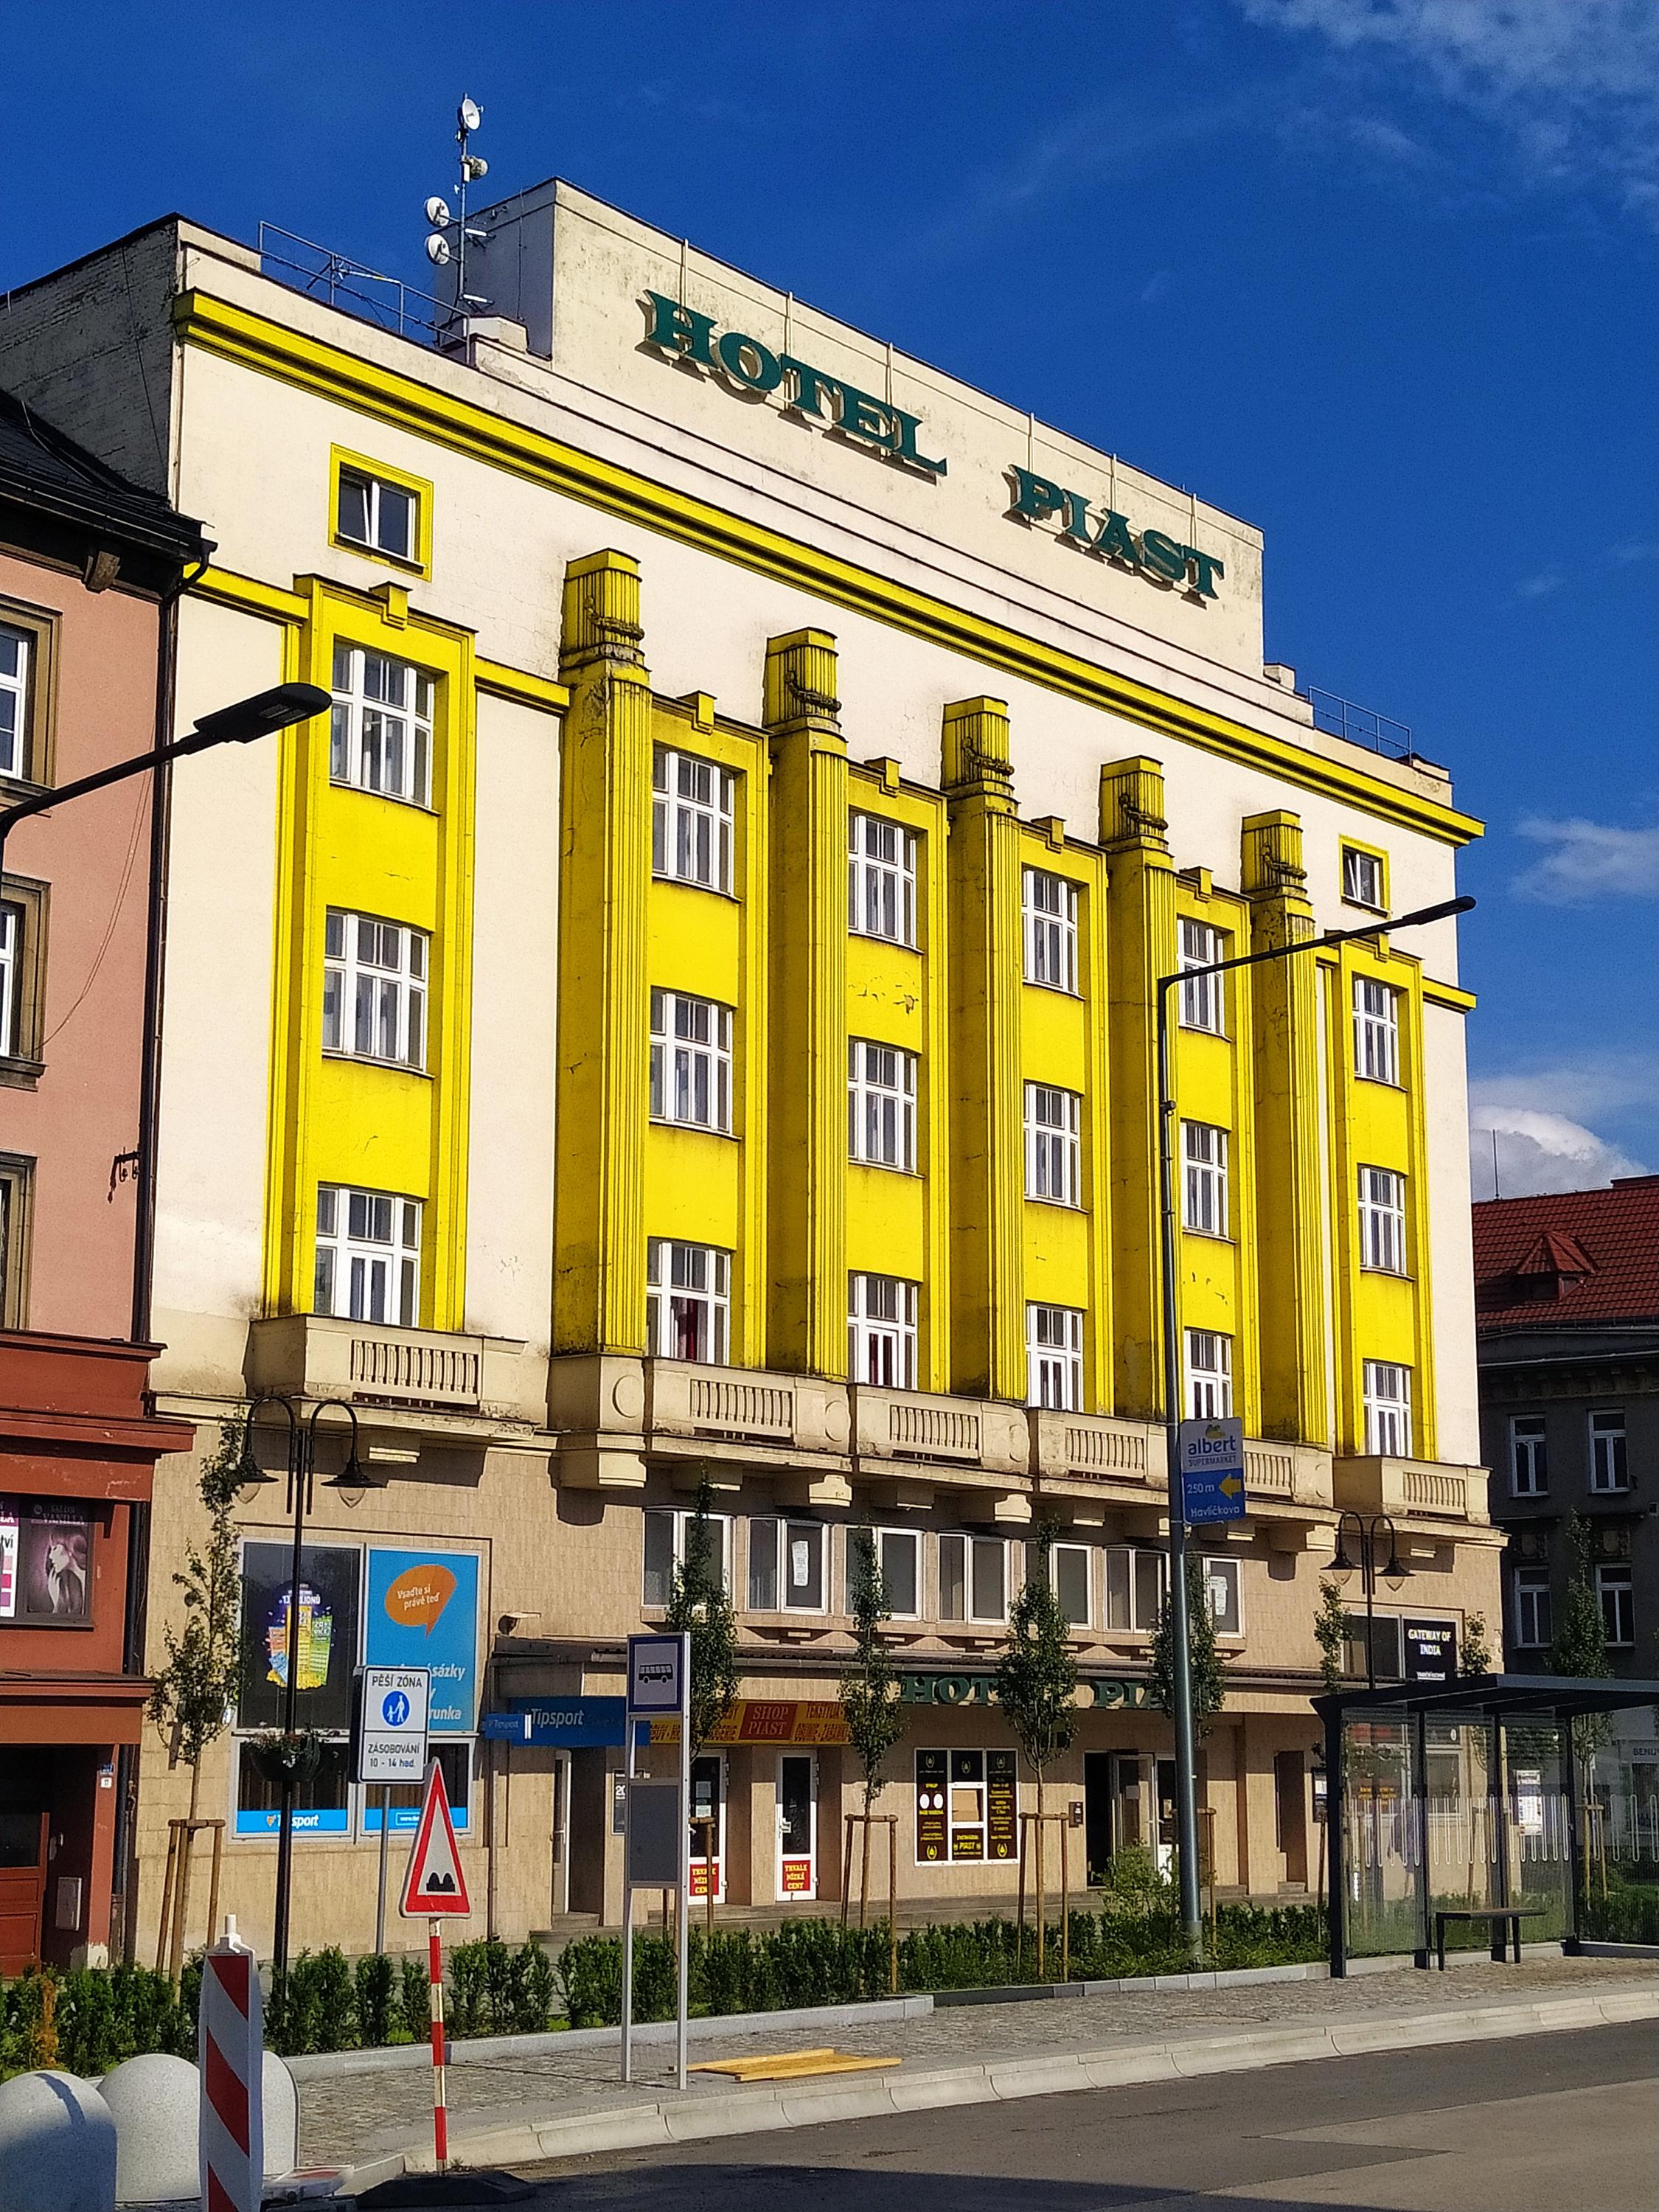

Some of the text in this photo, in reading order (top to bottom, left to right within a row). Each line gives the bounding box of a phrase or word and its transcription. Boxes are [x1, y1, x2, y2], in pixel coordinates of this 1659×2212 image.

[643, 289, 1224, 599] HOTEL PIAST
[1188, 1436, 1237, 1455] albert
[1189, 1455, 1236, 1467] SUPERMARKET
[1187, 1484, 1215, 1494] 250 m
[1191, 1505, 1240, 1517] Havlíčkova
[397, 1583, 431, 1599] Vsaďte si
[404, 1596, 425, 1611] právě
[1408, 1629, 1451, 1642] GATEWAY OF
[1419, 1644, 1441, 1656] INDIA
[431, 1663, 466, 1681] sázky
[372, 1674, 422, 1688] PĚŠÍ ZÓNA
[429, 1705, 462, 1720] runka
[531, 1708, 585, 1728] Tipsport
[753, 1705, 789, 1720] SHOP
[748, 1721, 787, 1735] PIAST
[368, 1742, 420, 1754] ZÁSOBOVÁNÍ
[370, 1758, 378, 1767] 10
[389, 1758, 397, 1767] 14
[277, 1814, 319, 1829] Tsport
[692, 1868, 717, 1876] TRVAE
